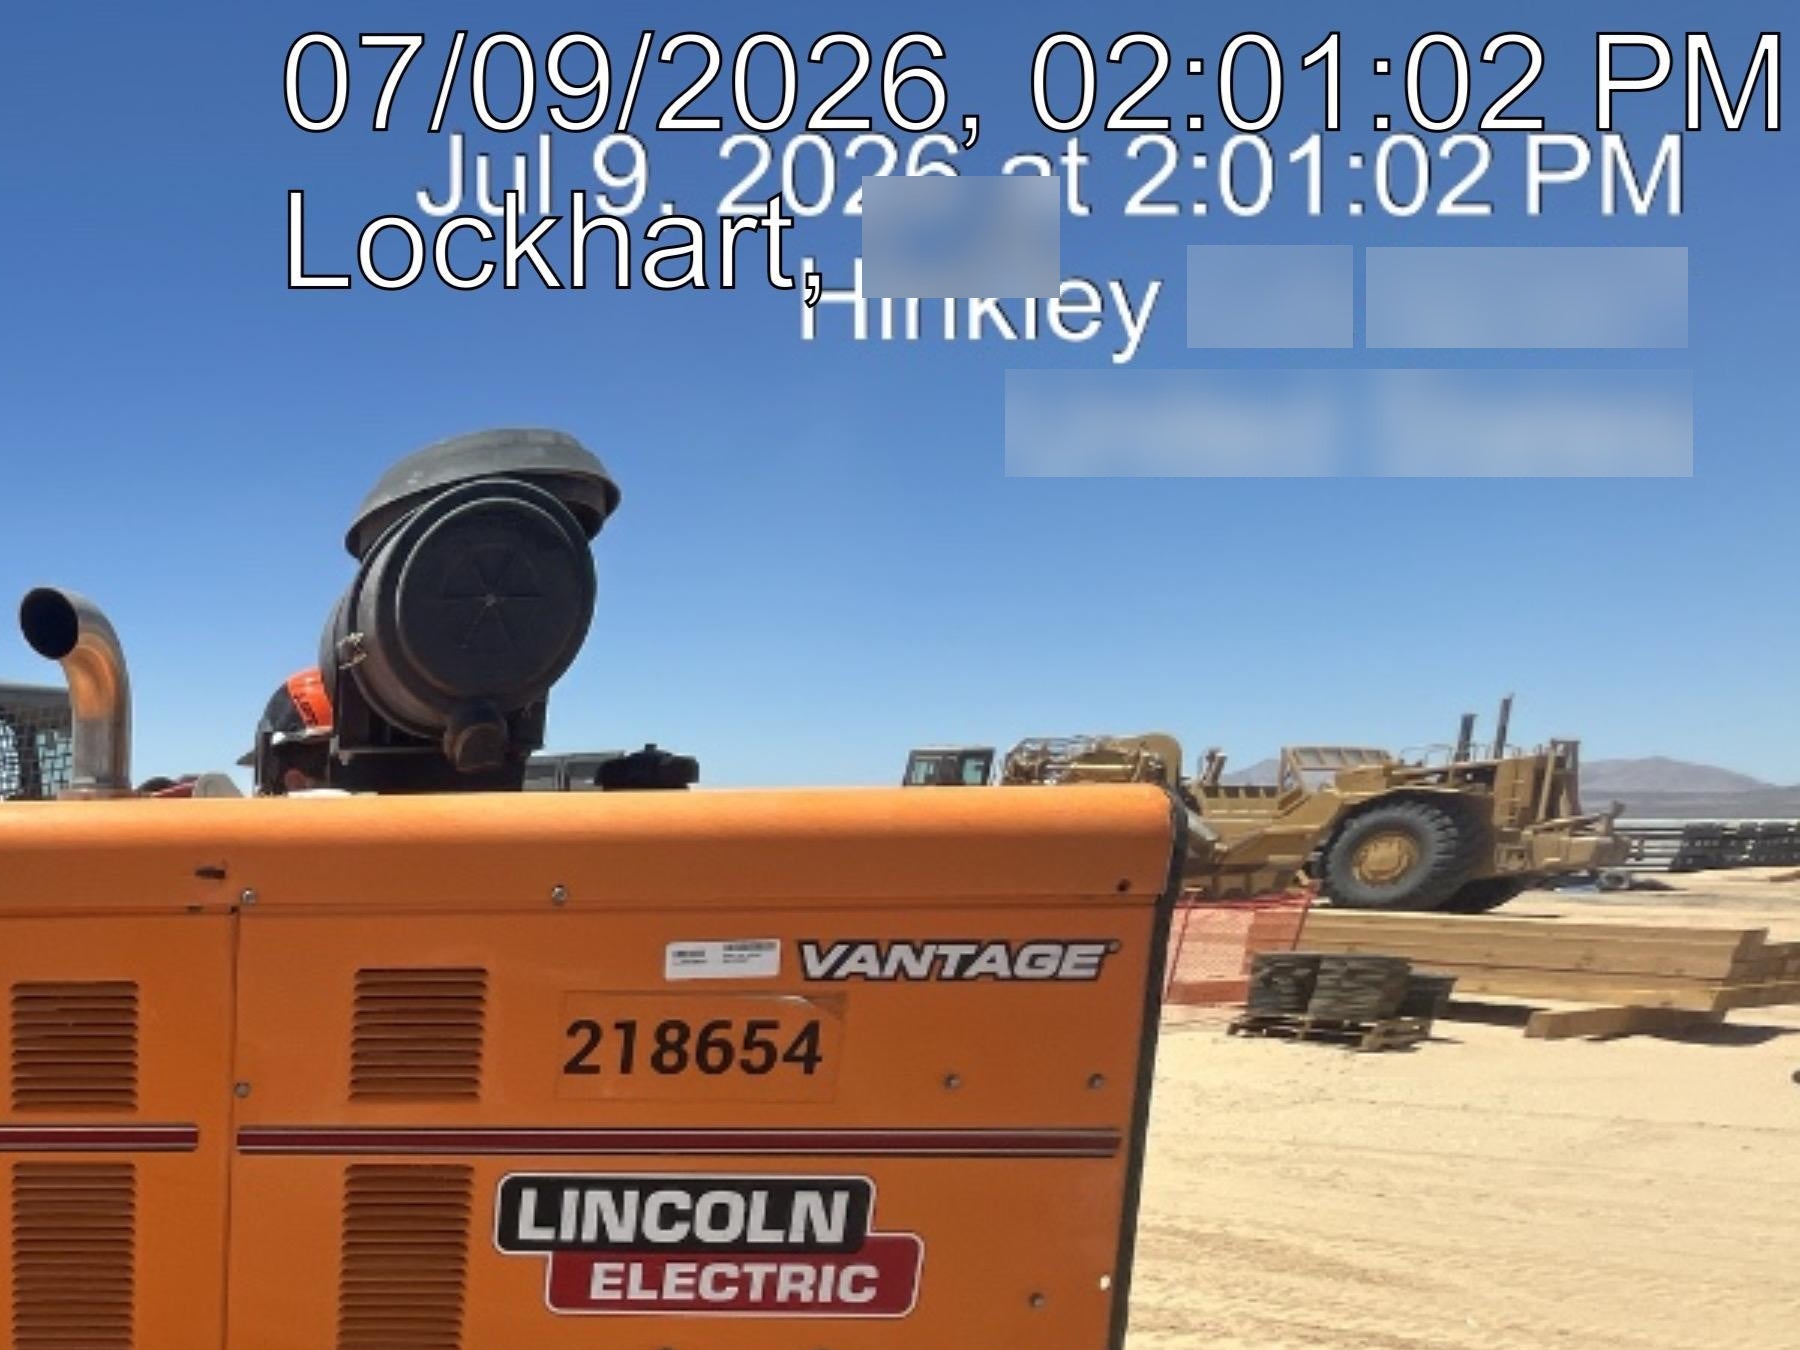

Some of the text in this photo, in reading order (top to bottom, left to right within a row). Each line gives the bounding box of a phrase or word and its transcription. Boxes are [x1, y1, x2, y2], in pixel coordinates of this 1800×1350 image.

[802, 943, 1105, 978] VANTAGE
[563, 1018, 824, 1076] 218654
[517, 1189, 850, 1244] LINCOLN
[589, 1262, 879, 1303] ELECTRIC
